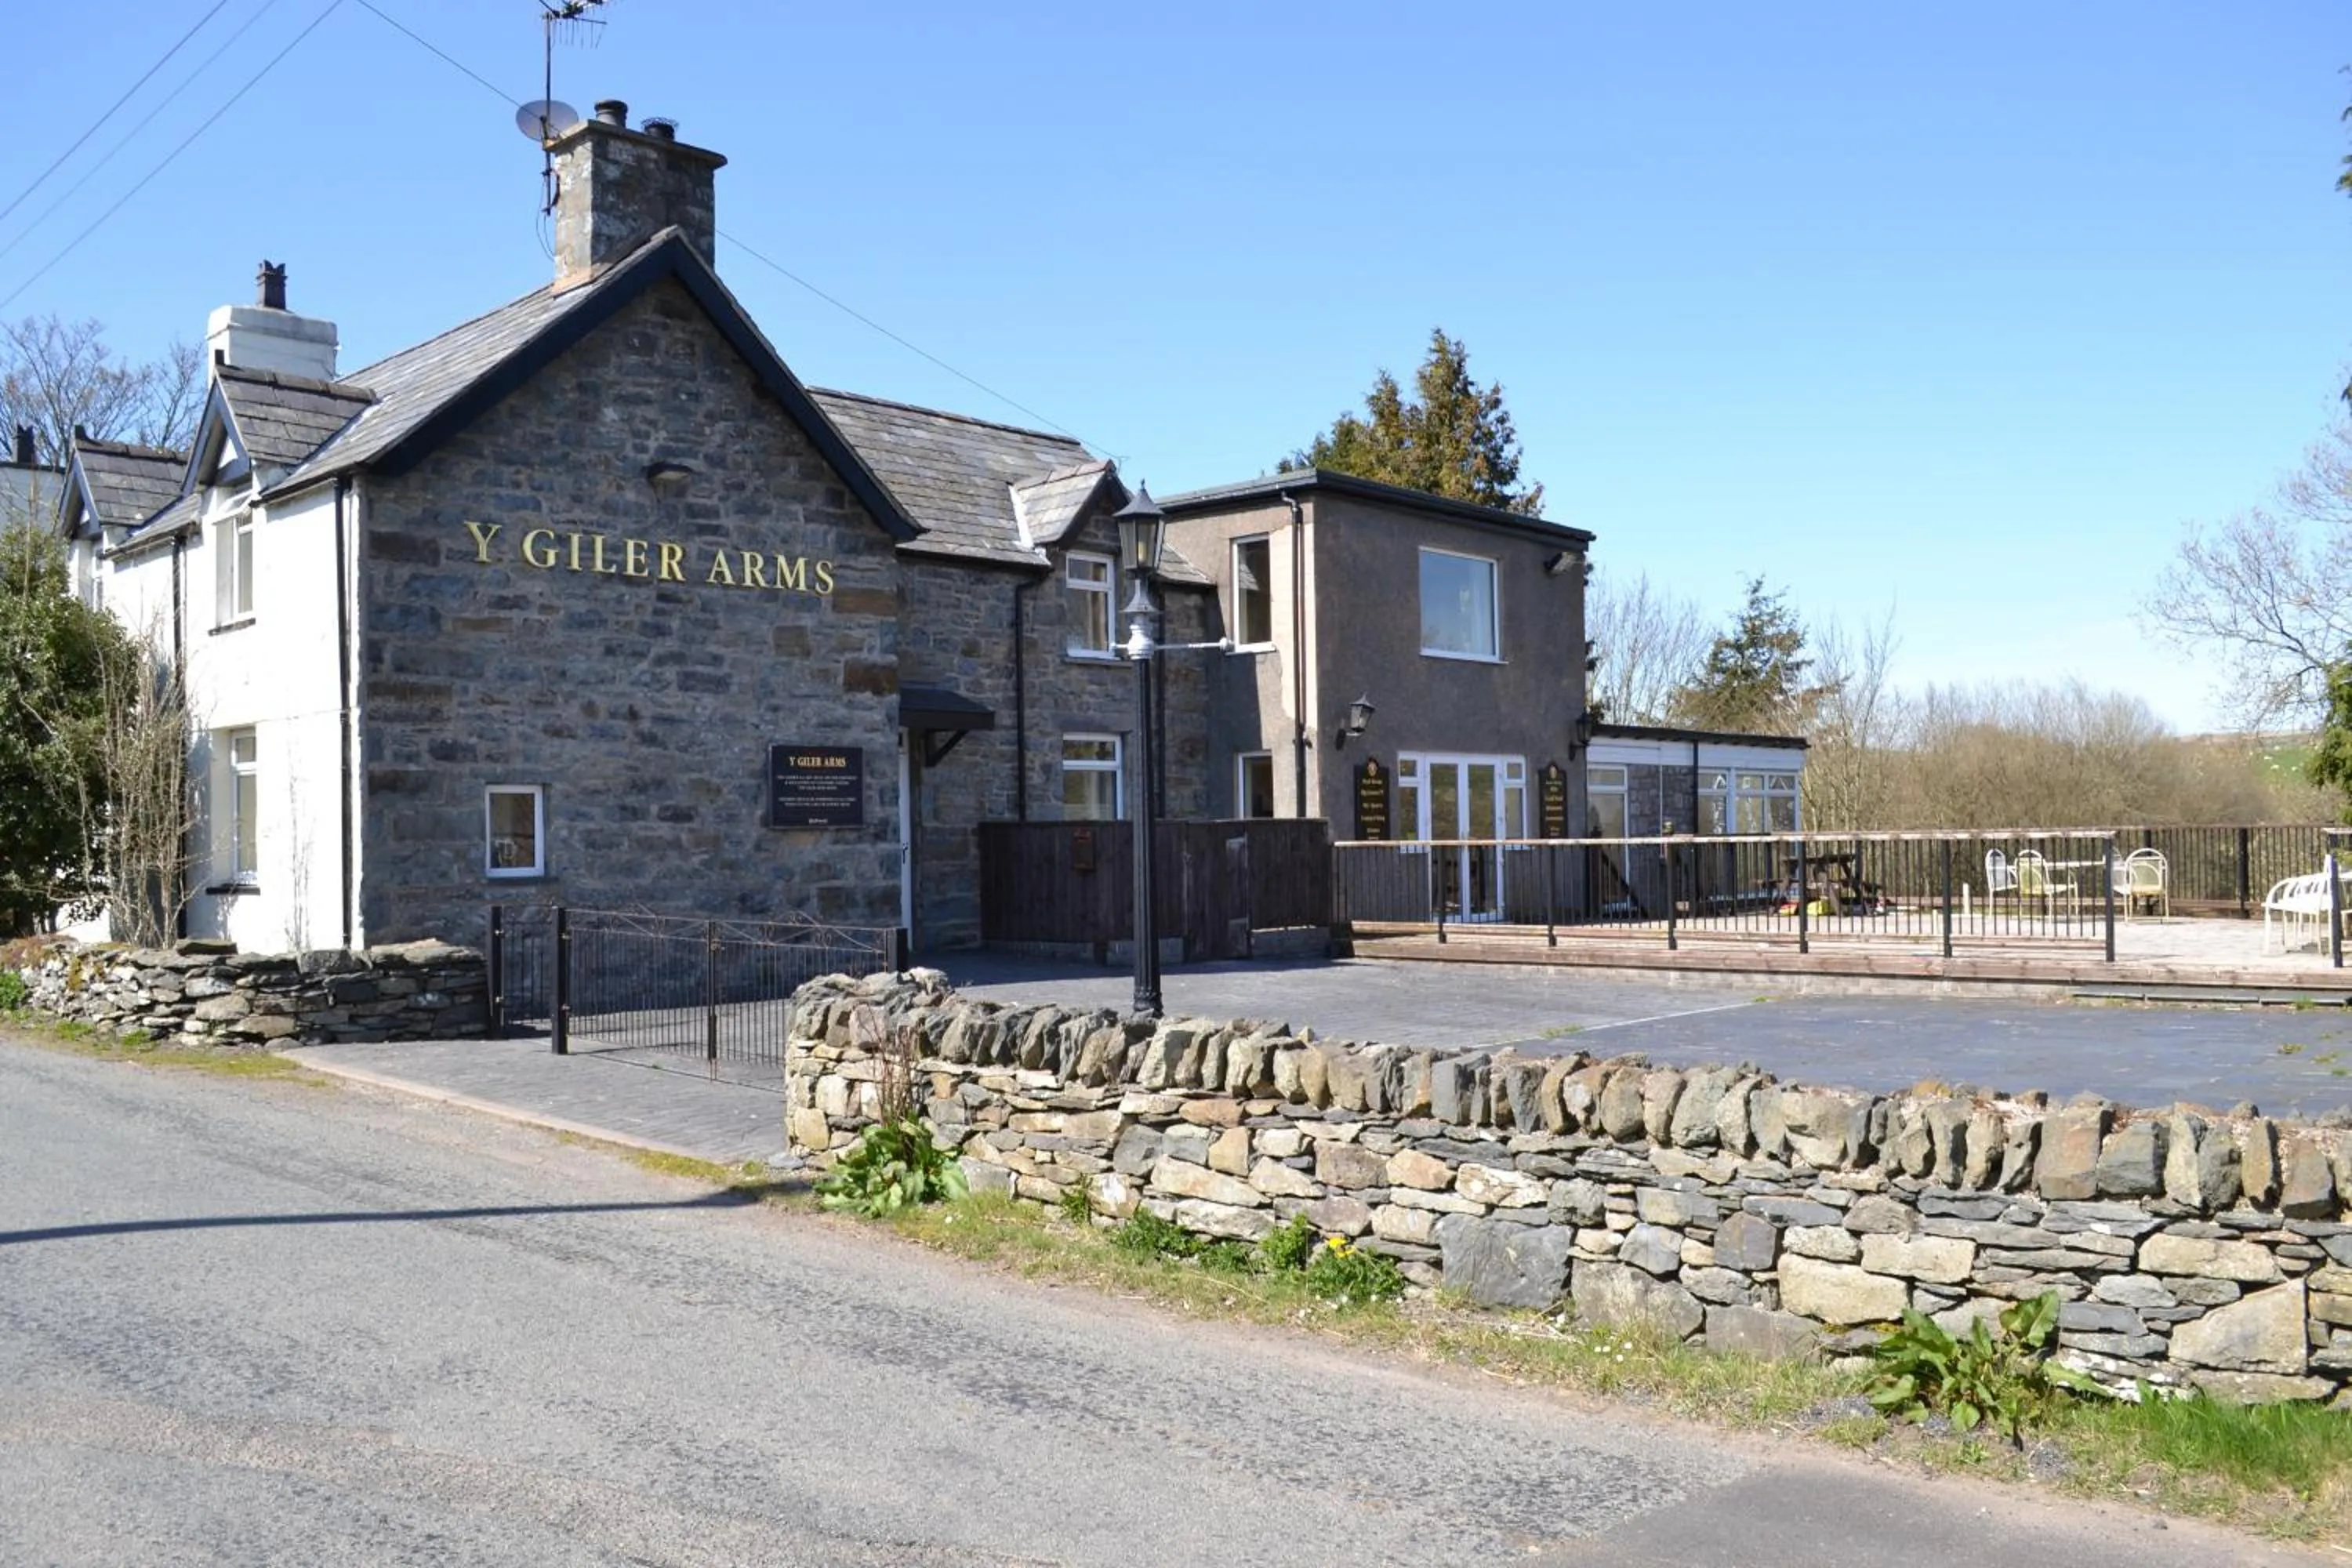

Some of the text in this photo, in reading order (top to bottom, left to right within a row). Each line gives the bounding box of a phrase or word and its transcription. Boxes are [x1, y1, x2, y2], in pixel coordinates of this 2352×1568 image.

[465, 521, 834, 594] Y GILER ARMS
[789, 757, 847, 768] Y GILER ARMS
